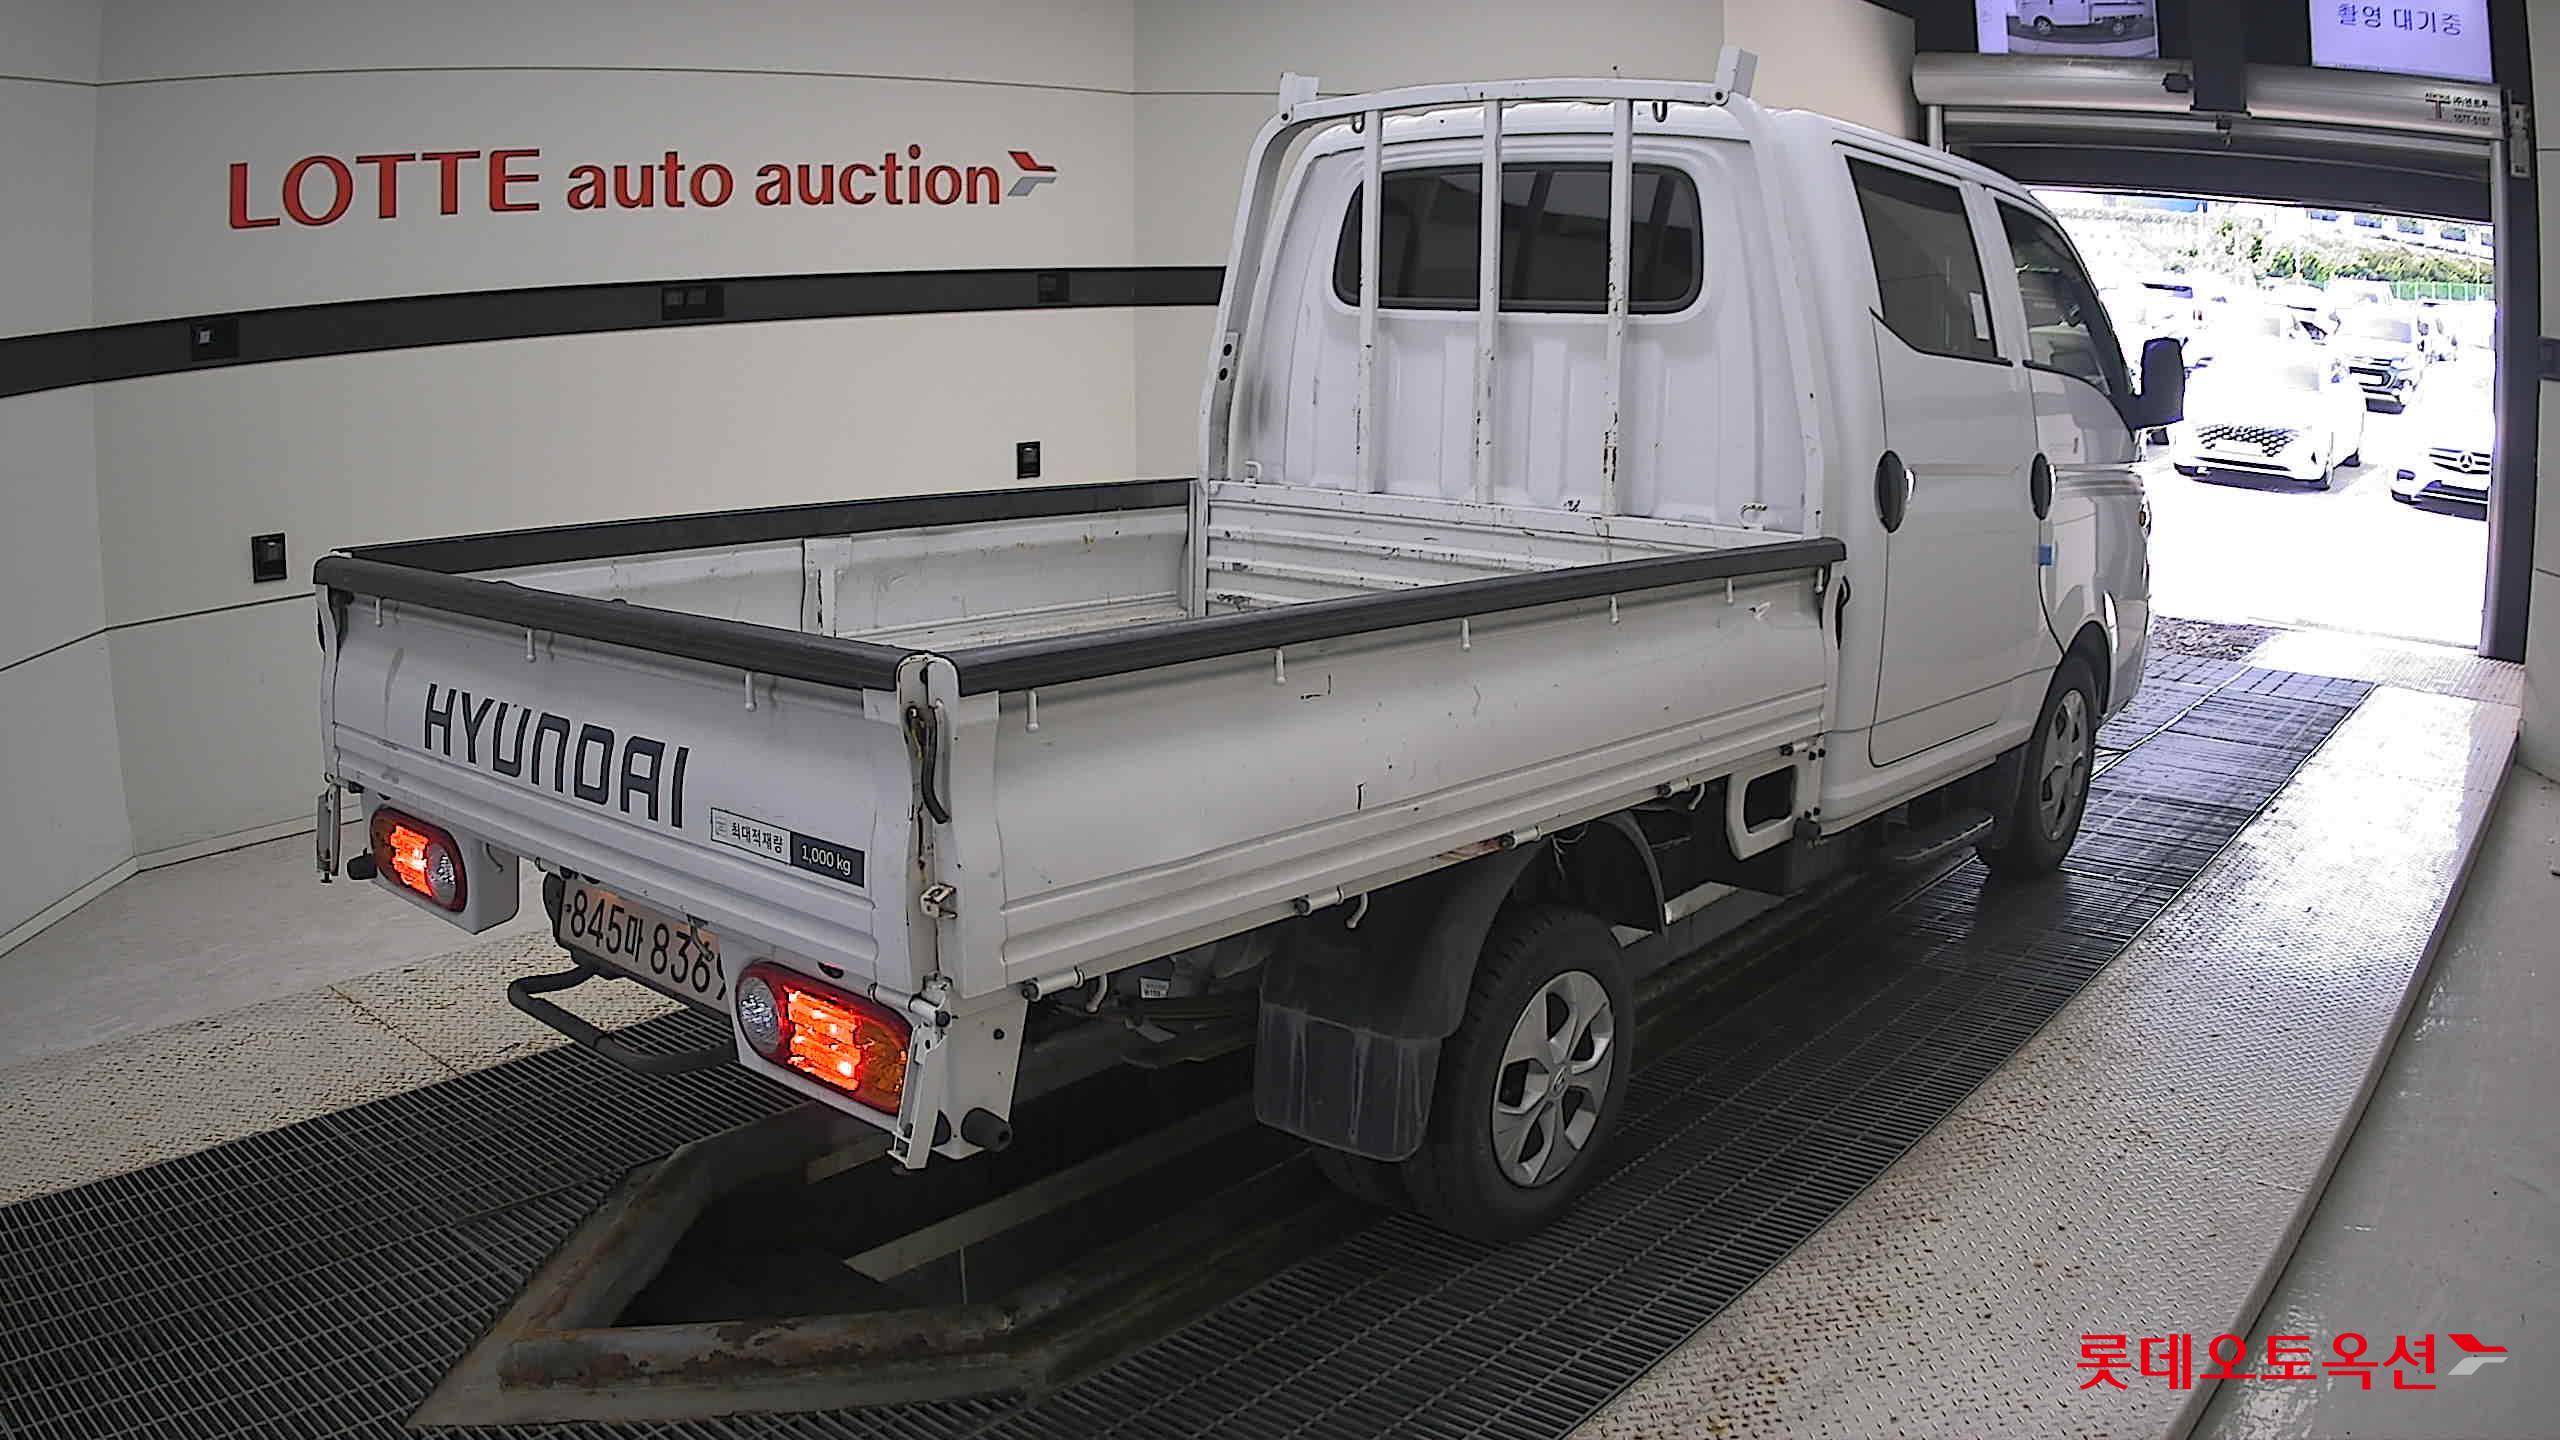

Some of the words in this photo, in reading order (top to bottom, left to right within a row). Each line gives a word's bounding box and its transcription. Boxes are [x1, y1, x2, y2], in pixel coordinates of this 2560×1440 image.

[2337, 3, 2382, 29] 촬영
[2393, 8, 2462, 36] 대기중
[228, 148, 541, 230] LOTTE
[566, 150, 734, 209] auto
[754, 143, 1001, 208] auction
[423, 683, 691, 829] HYUNDAI
[731, 822, 784, 854] 최대적재량
[801, 844, 834, 868] 1,000
[836, 853, 852, 876] kg
[570, 889, 644, 963] 845마
